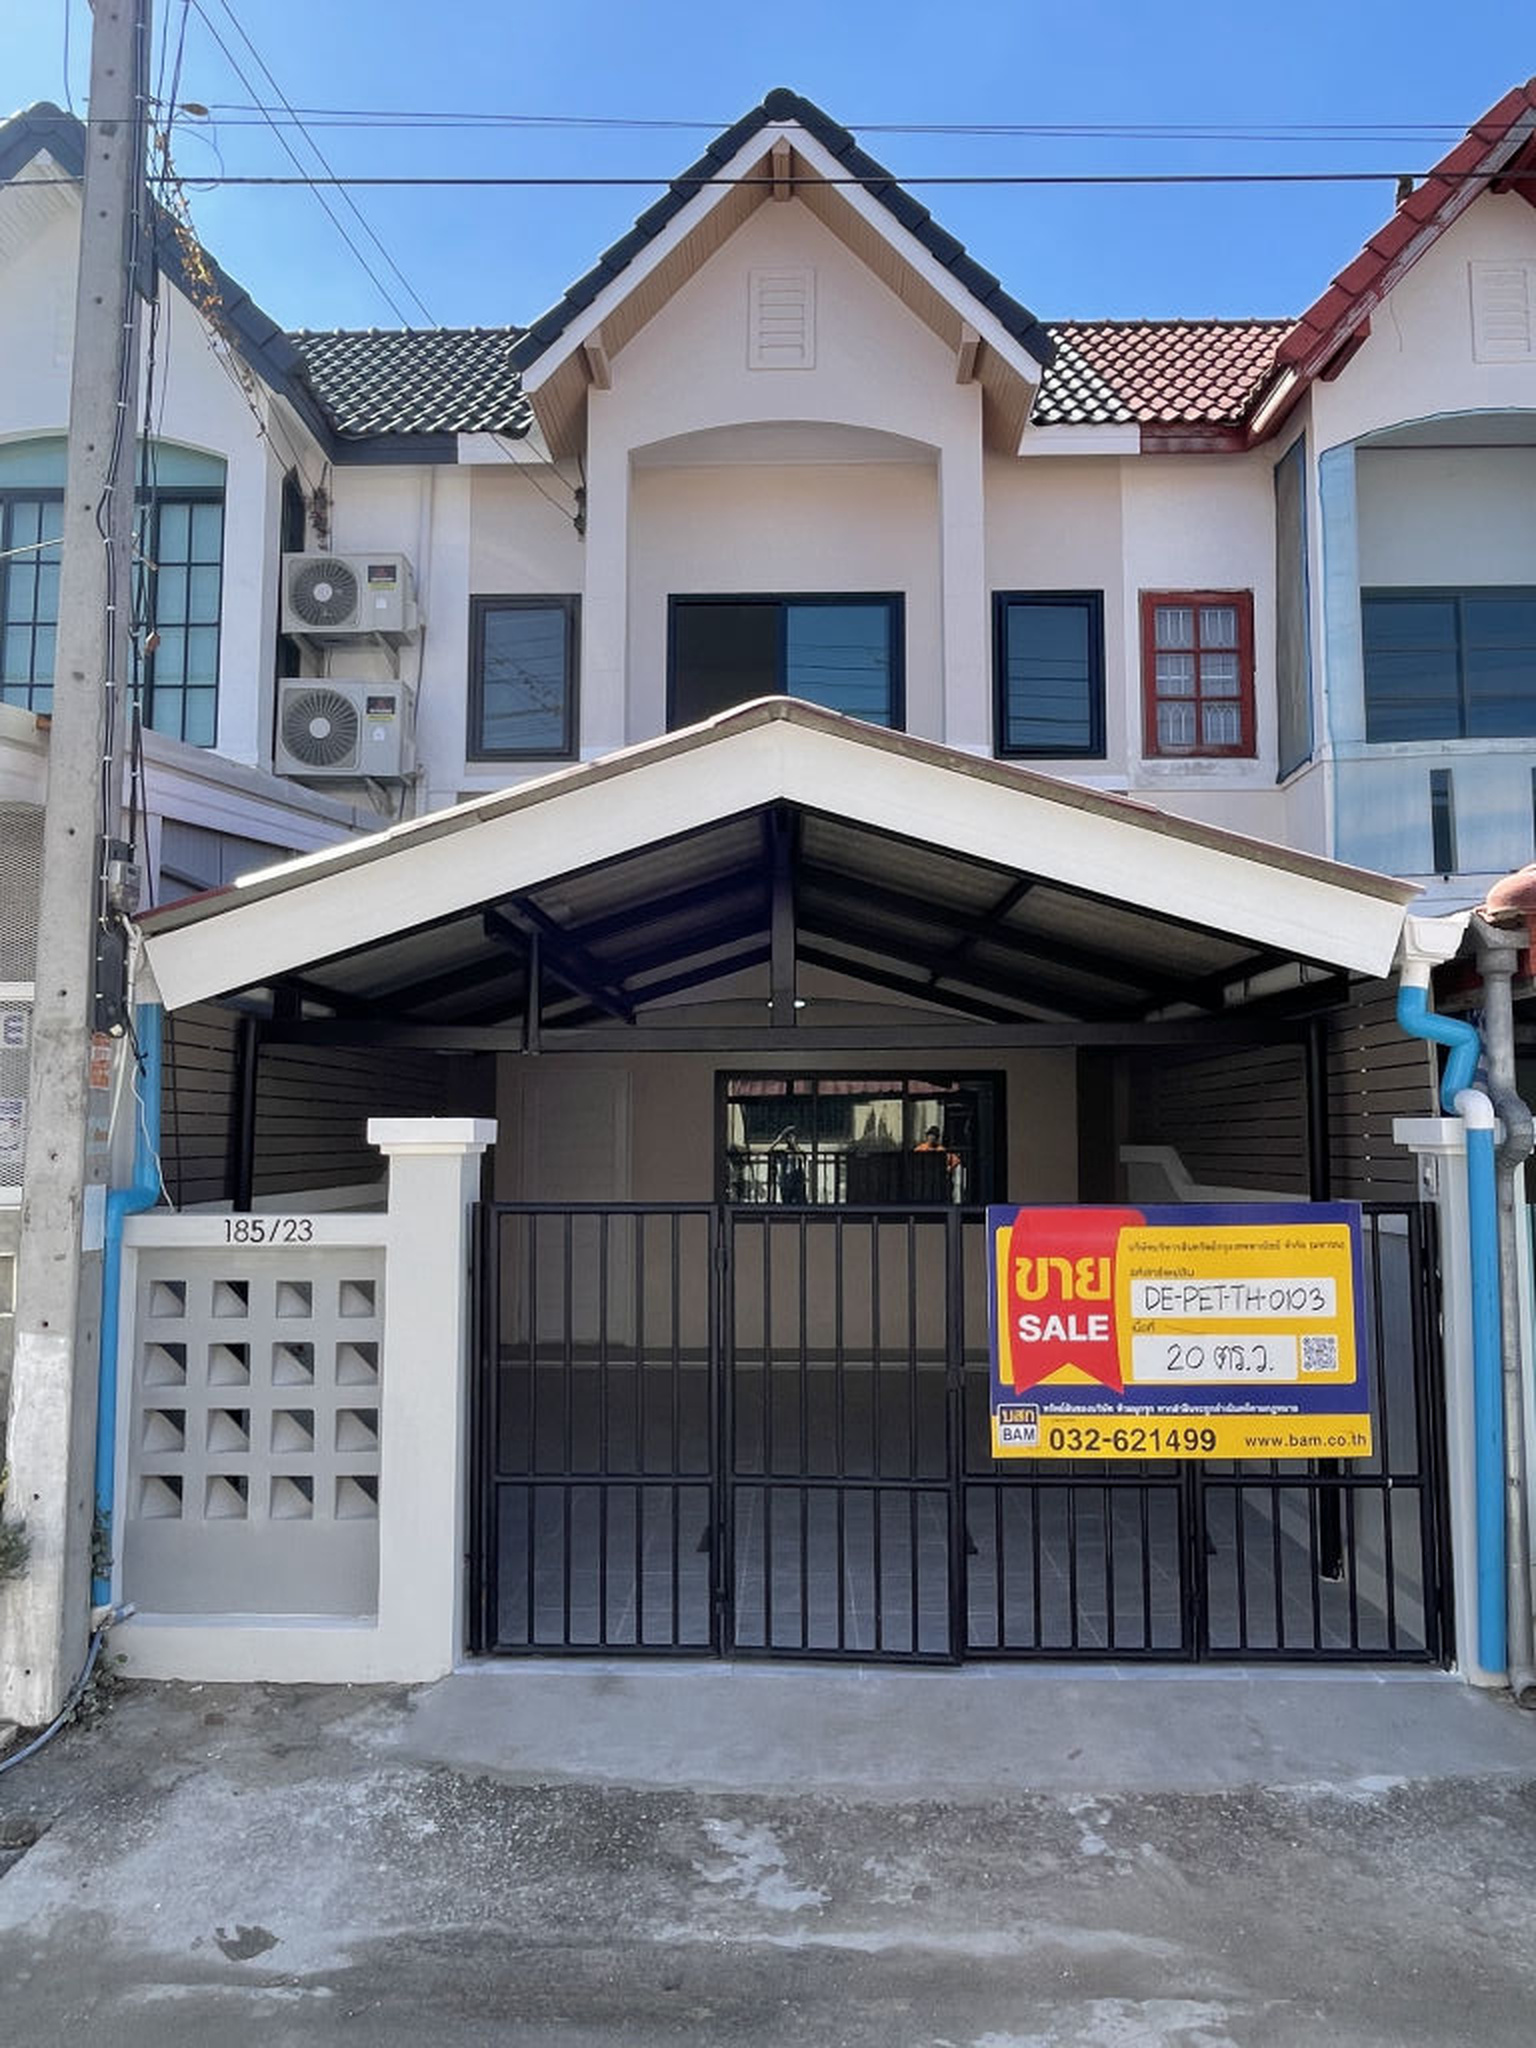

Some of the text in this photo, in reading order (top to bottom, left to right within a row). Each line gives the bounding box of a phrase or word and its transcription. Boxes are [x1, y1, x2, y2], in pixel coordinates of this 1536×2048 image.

[224, 1219, 313, 1243] 185/23
[1015, 1257, 1111, 1301] ขาย
[1145, 1284, 1326, 1312] DE-PET-TH-0103
[1018, 1314, 1109, 1342] SALE
[1167, 1343, 1274, 1372] 20 ตร.ว.
[1003, 1427, 1035, 1441] BAM
[1049, 1427, 1217, 1452] 032-621499
[1245, 1433, 1367, 1447] www.bam.co.th
